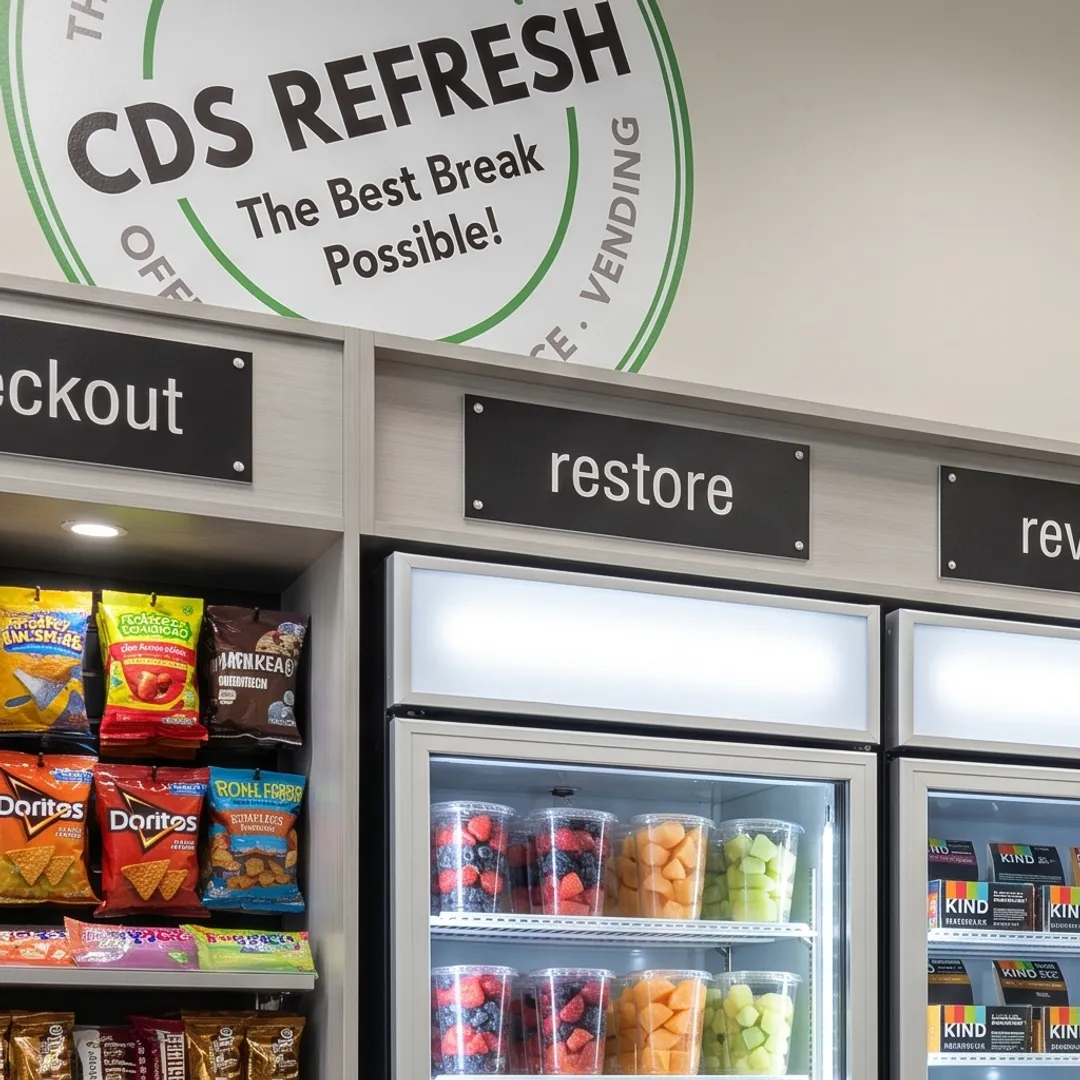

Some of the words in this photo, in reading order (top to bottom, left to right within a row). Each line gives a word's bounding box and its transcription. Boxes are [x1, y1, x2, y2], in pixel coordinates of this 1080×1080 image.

[66, 85, 255, 195] CDS
[267, 4, 631, 152] REFRESH
[236, 193, 321, 240] The
[327, 165, 422, 220] Best
[432, 134, 545, 194] Break
[578, 116, 642, 305] VENDING
[120, 224, 203, 303] OFF
[323, 206, 503, 286] Possible!
[0, 358, 184, 436] ckout
[550, 450, 734, 516] restore
[0, 796, 83, 820] Doritos
[110, 809, 198, 832] Doritos
[1001, 853, 1035, 865] KIND
[945, 898, 990, 915] KIND
[1002, 968, 1038, 979] KIND
[943, 1022, 987, 1038] KIND
